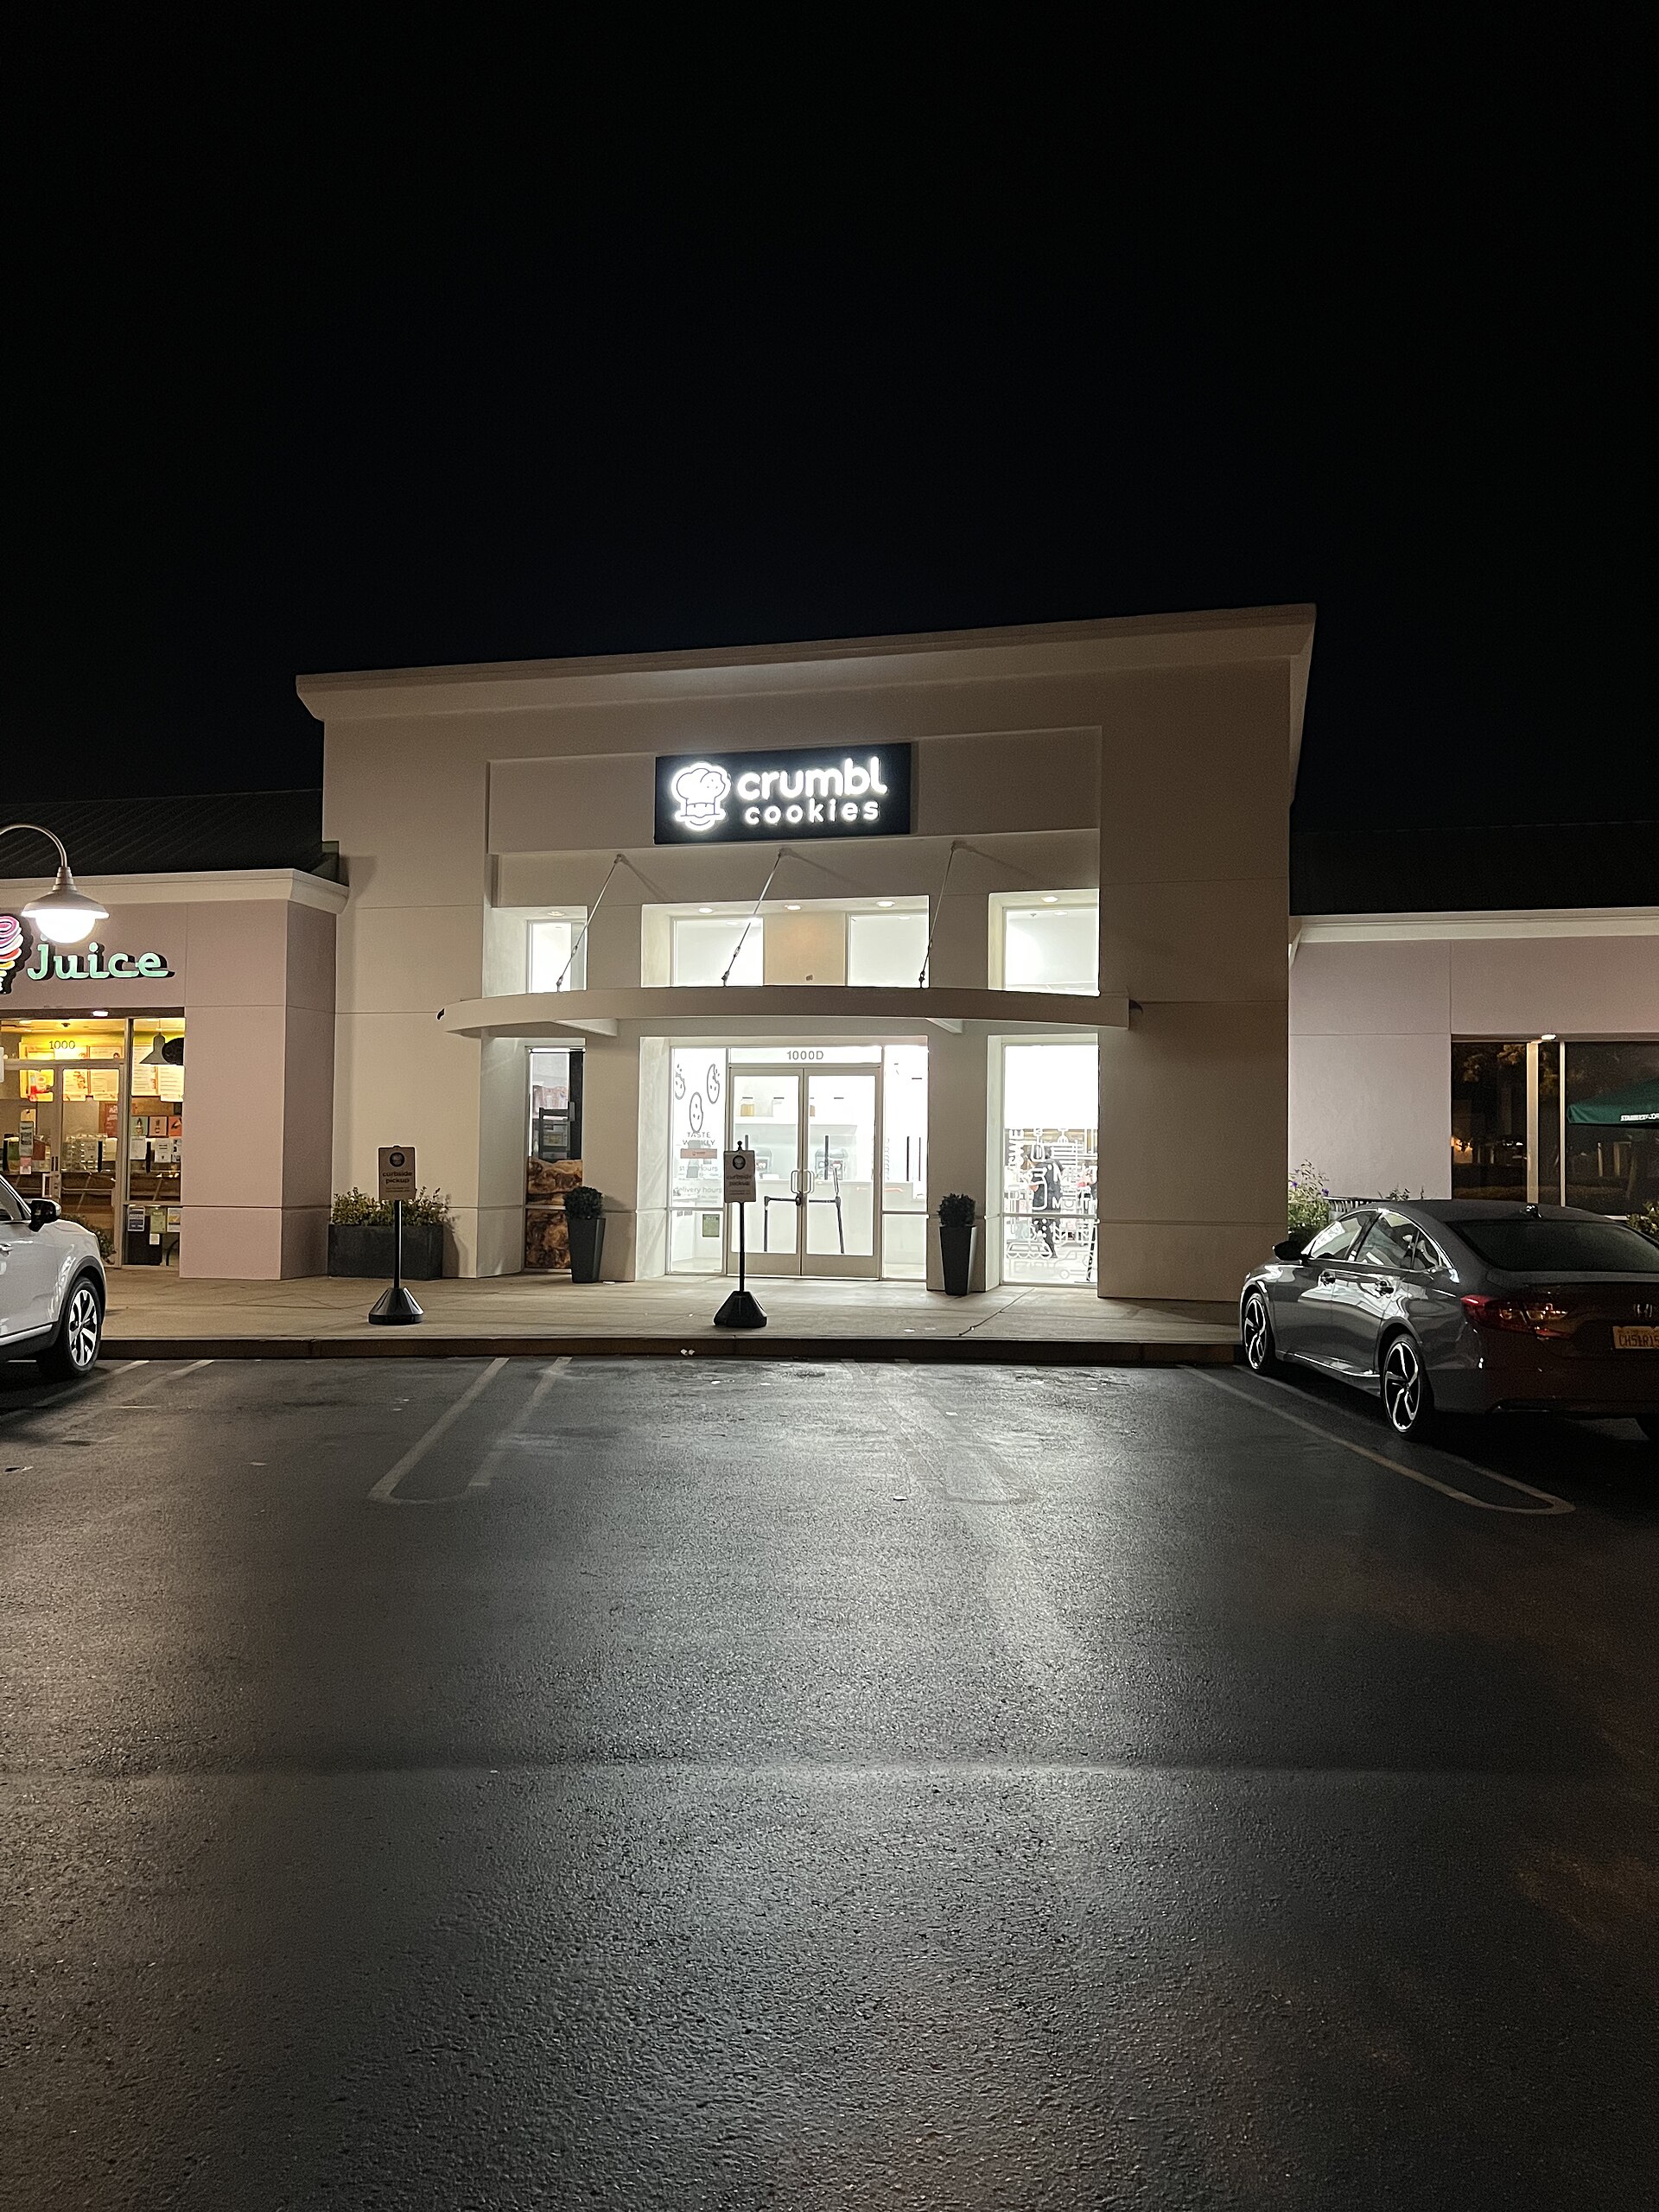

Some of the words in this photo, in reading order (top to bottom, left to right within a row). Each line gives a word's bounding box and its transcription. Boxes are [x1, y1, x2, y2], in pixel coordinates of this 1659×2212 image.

[736, 755, 889, 800] crumbl
[744, 798, 880, 825] cookies
[48, 1039, 76, 1050] 1000
[786, 1050, 824, 1061] 1000D
